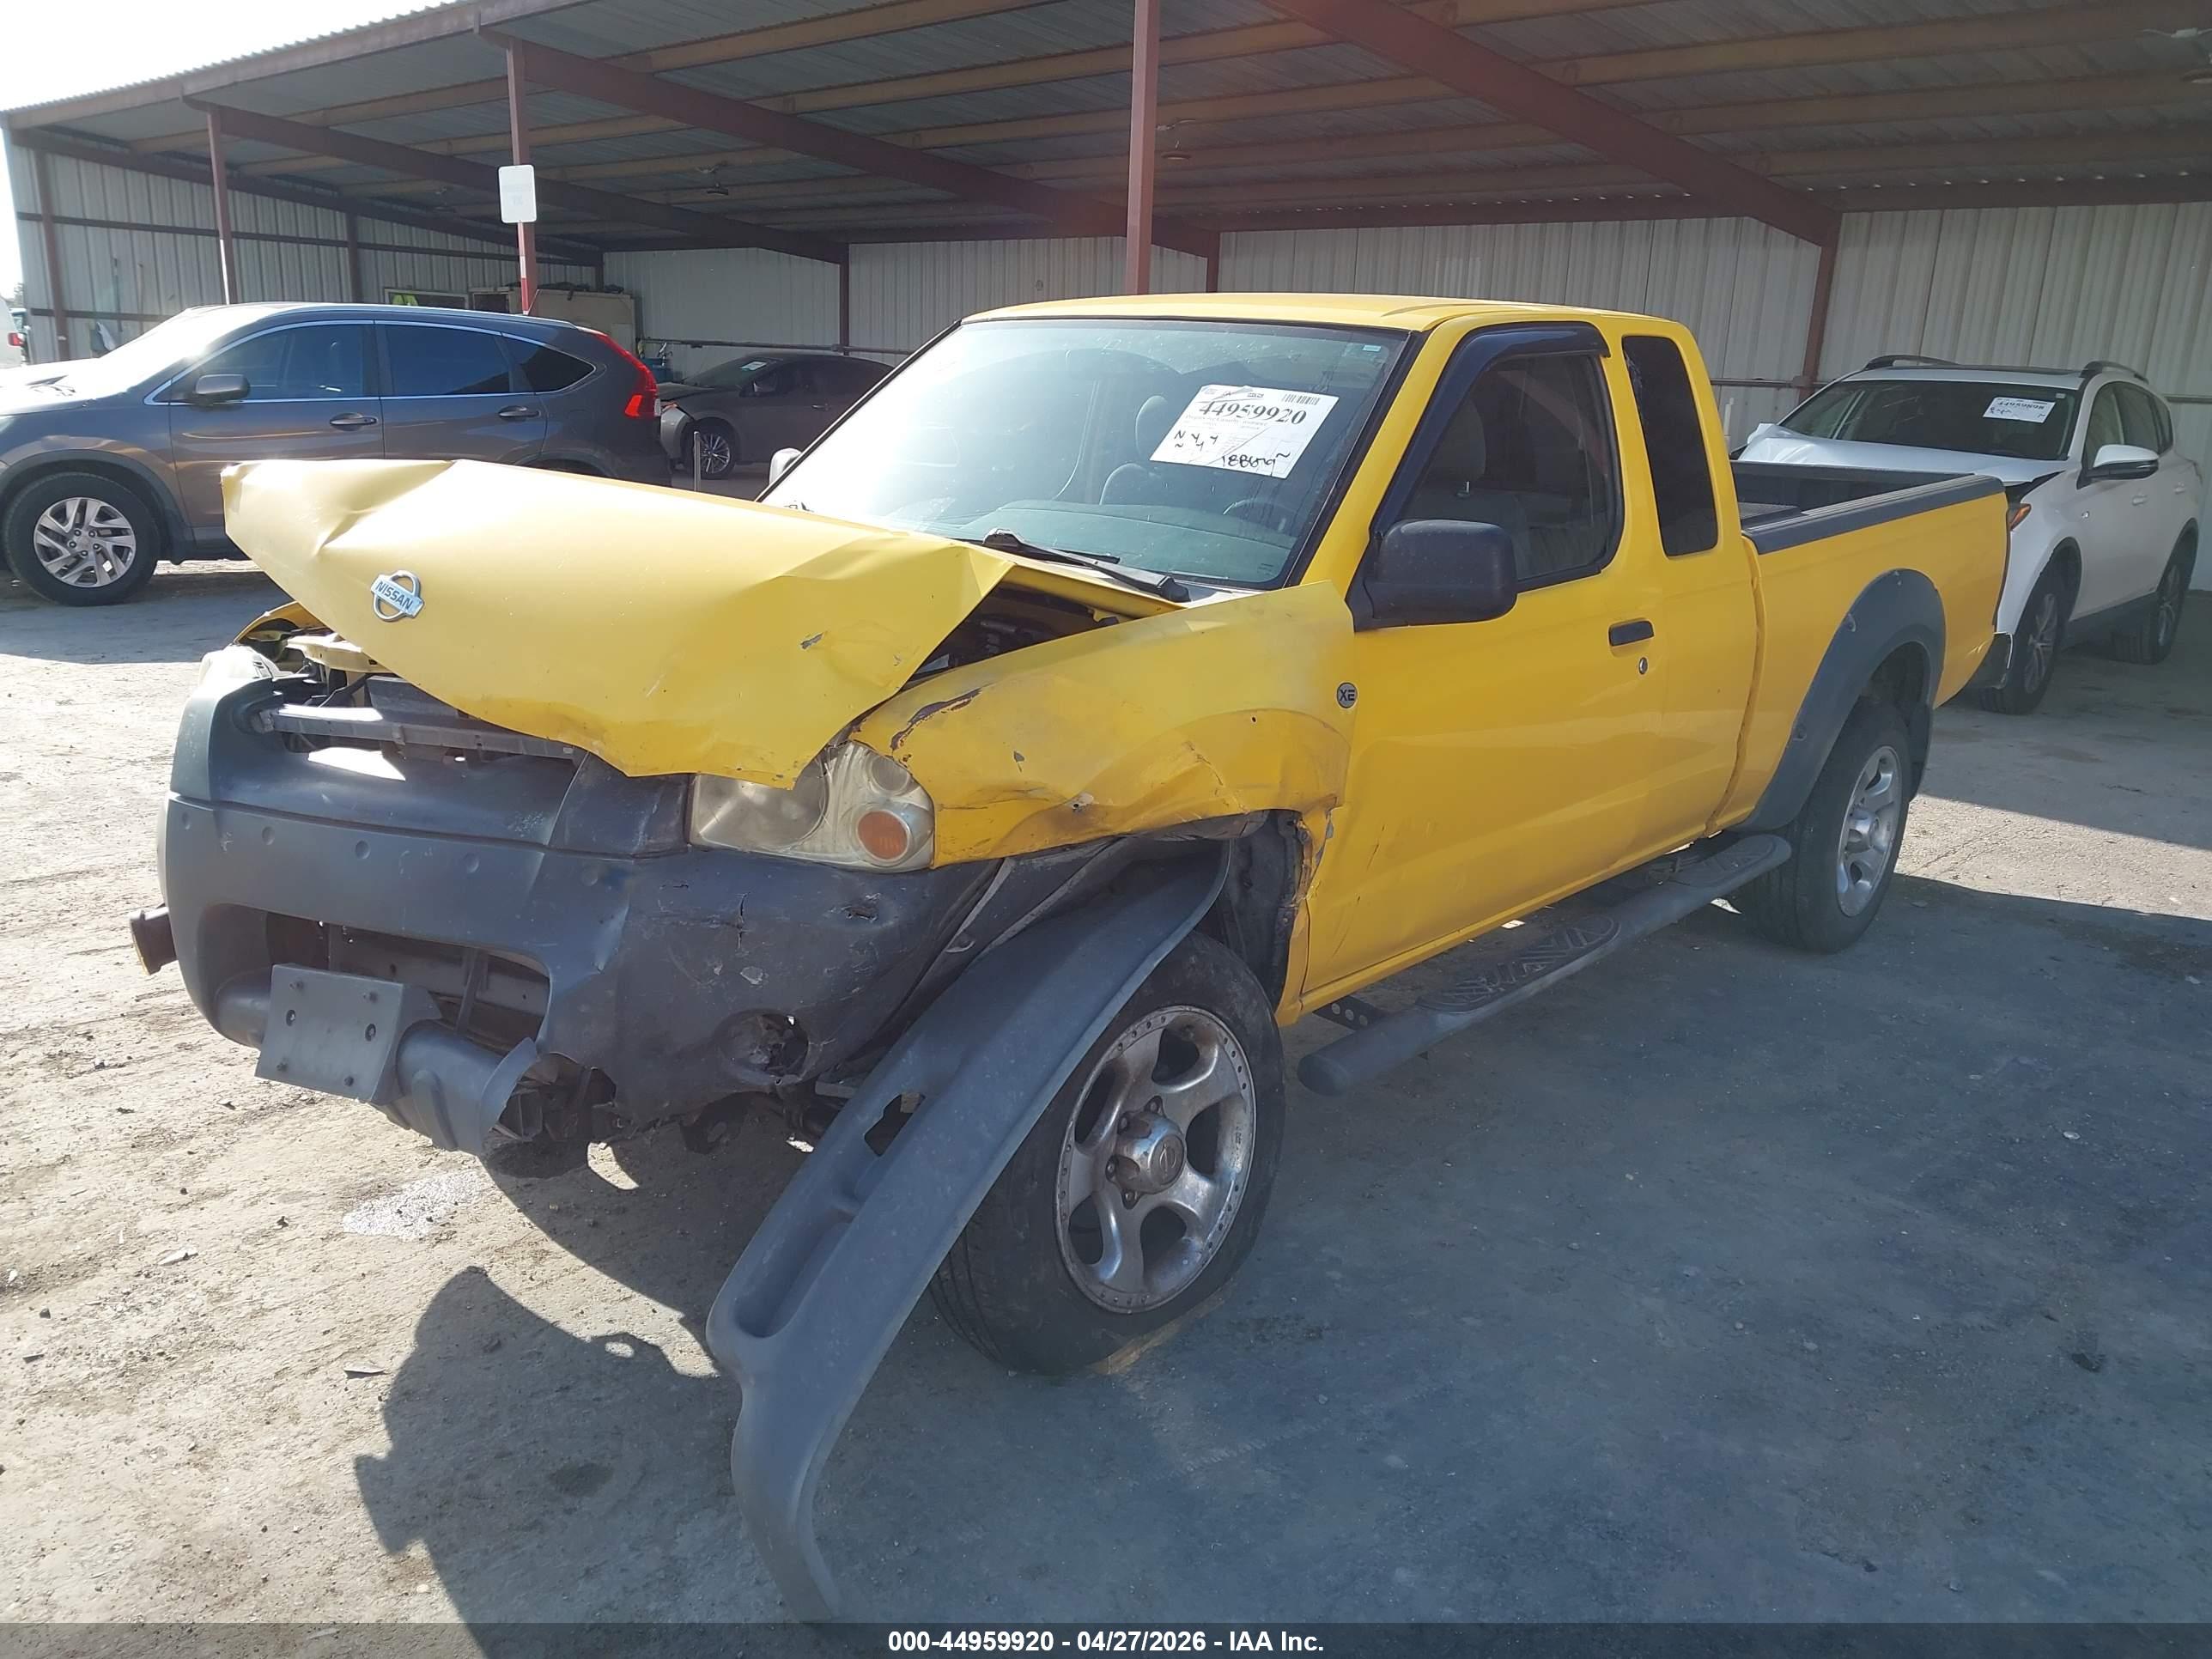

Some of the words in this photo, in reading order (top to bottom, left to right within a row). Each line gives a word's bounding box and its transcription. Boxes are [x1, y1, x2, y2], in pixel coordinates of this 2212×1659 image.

[1199, 401, 1307, 424] 44959920
[375, 580, 413, 610] NISSAN
[1340, 689, 1355, 702] XE
